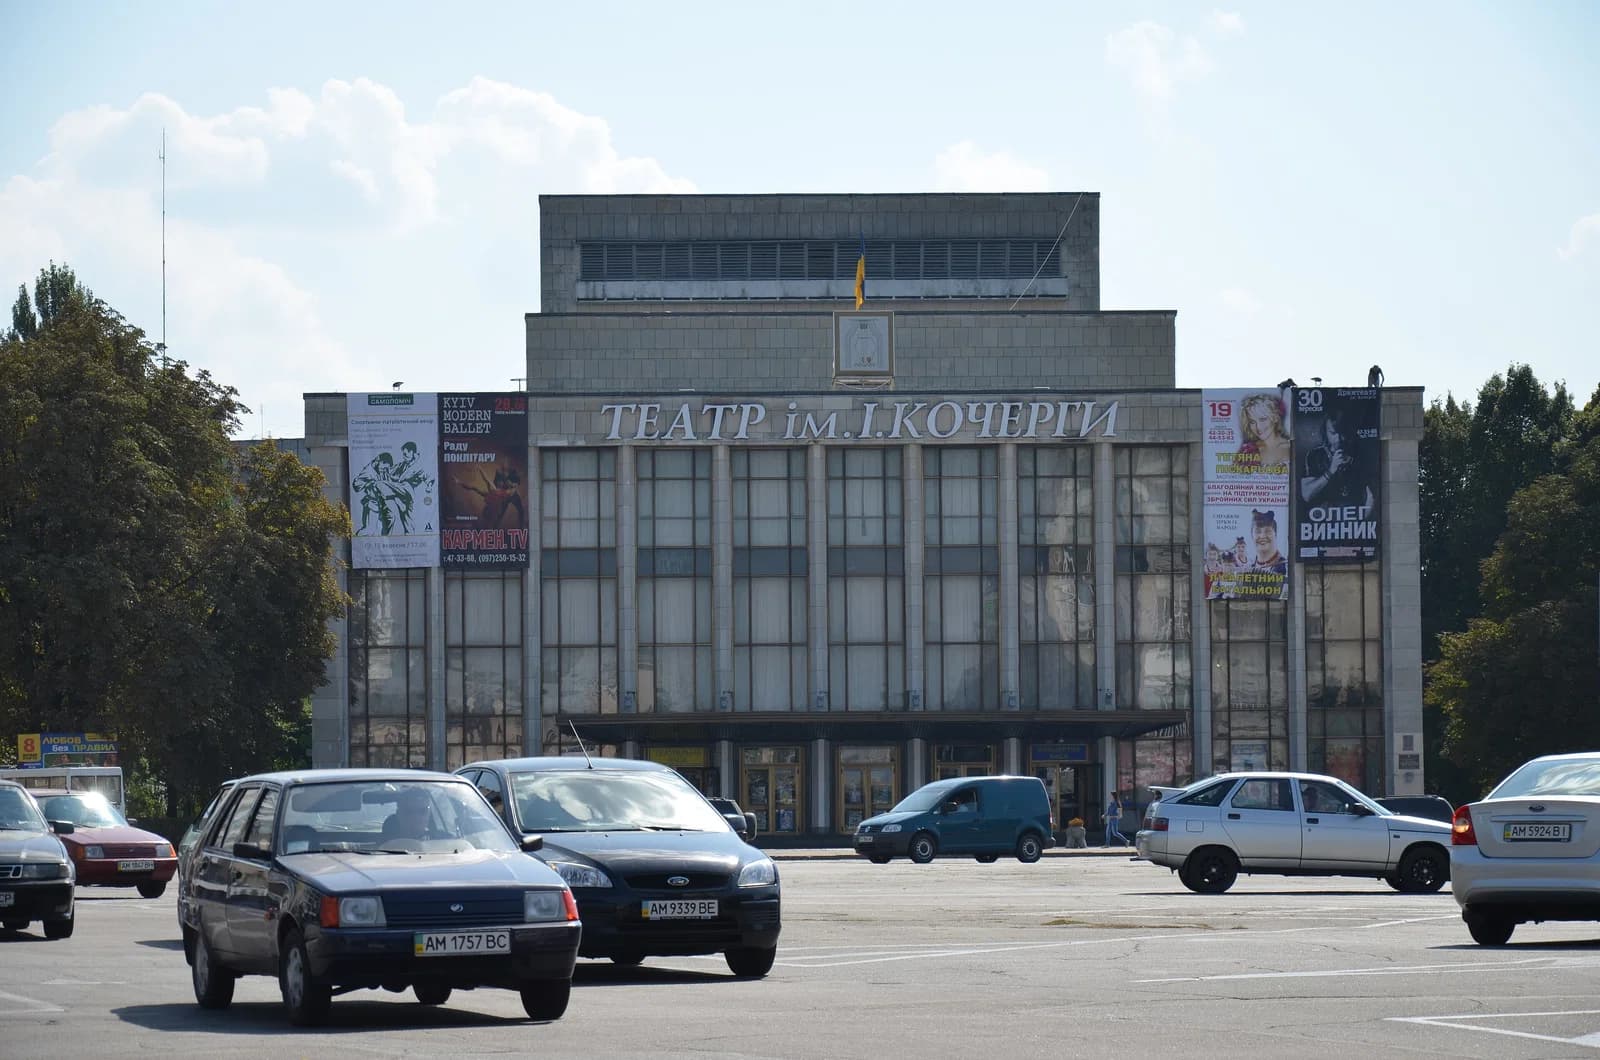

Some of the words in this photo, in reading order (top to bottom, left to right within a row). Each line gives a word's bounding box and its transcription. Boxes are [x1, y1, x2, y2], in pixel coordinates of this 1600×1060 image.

[443, 397, 475, 408] KYIV
[1298, 389, 1323, 407] 30
[443, 410, 491, 421] MODERN
[1209, 402, 1232, 417] 19
[600, 402, 767, 440] ТЕАТР
[443, 422, 492, 434] BALLET
[443, 441, 468, 452] Раду
[1215, 453, 1263, 462] ТЕТЯНА
[1309, 506, 1372, 522] ОЛЕГ
[1301, 521, 1377, 541] ВИННИК
[23, 738, 36, 752] 8
[42, 736, 82, 744] ЛЮБОВ
[72, 743, 116, 751] ПРАВИЛ
[1511, 826, 1527, 837] AM
[1528, 826, 1552, 837] 5924
[650, 903, 668, 915] AM
[669, 902, 697, 915] 9339
[698, 902, 716, 914] BE
[425, 936, 447, 951] AM
[450, 935, 483, 950] 1757
[485, 934, 507, 949] BC
